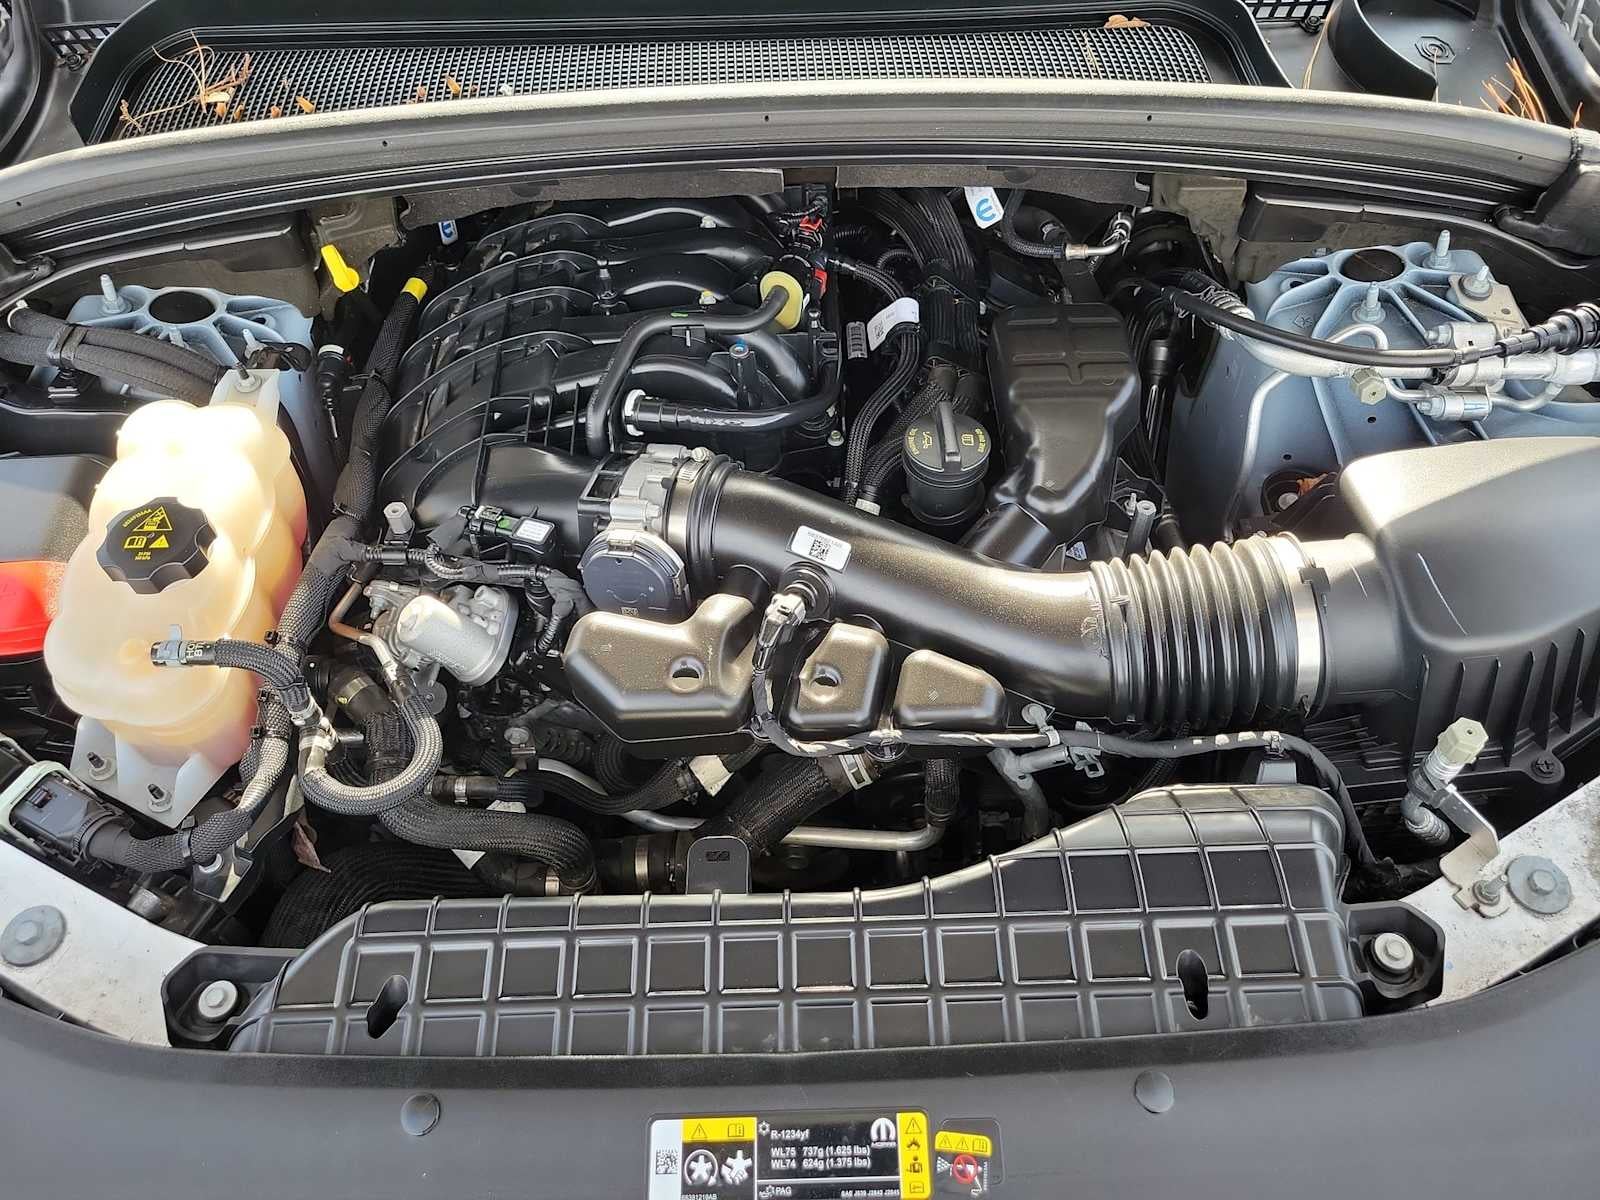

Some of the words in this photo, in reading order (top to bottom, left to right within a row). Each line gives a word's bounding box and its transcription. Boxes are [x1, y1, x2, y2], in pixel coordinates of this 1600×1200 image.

[770, 1129, 809, 1142] R-1234yf
[771, 1147, 796, 1157] WL75
[802, 1146, 824, 1158] 737g
[825, 1145, 852, 1157] (1.625
[853, 1145, 871, 1156] lbs)
[771, 1158, 796, 1169] WL74
[802, 1158, 824, 1170] 624g
[826, 1157, 852, 1169] (1.375
[853, 1156, 871, 1169] lbs)
[775, 1186, 792, 1197] PAG
